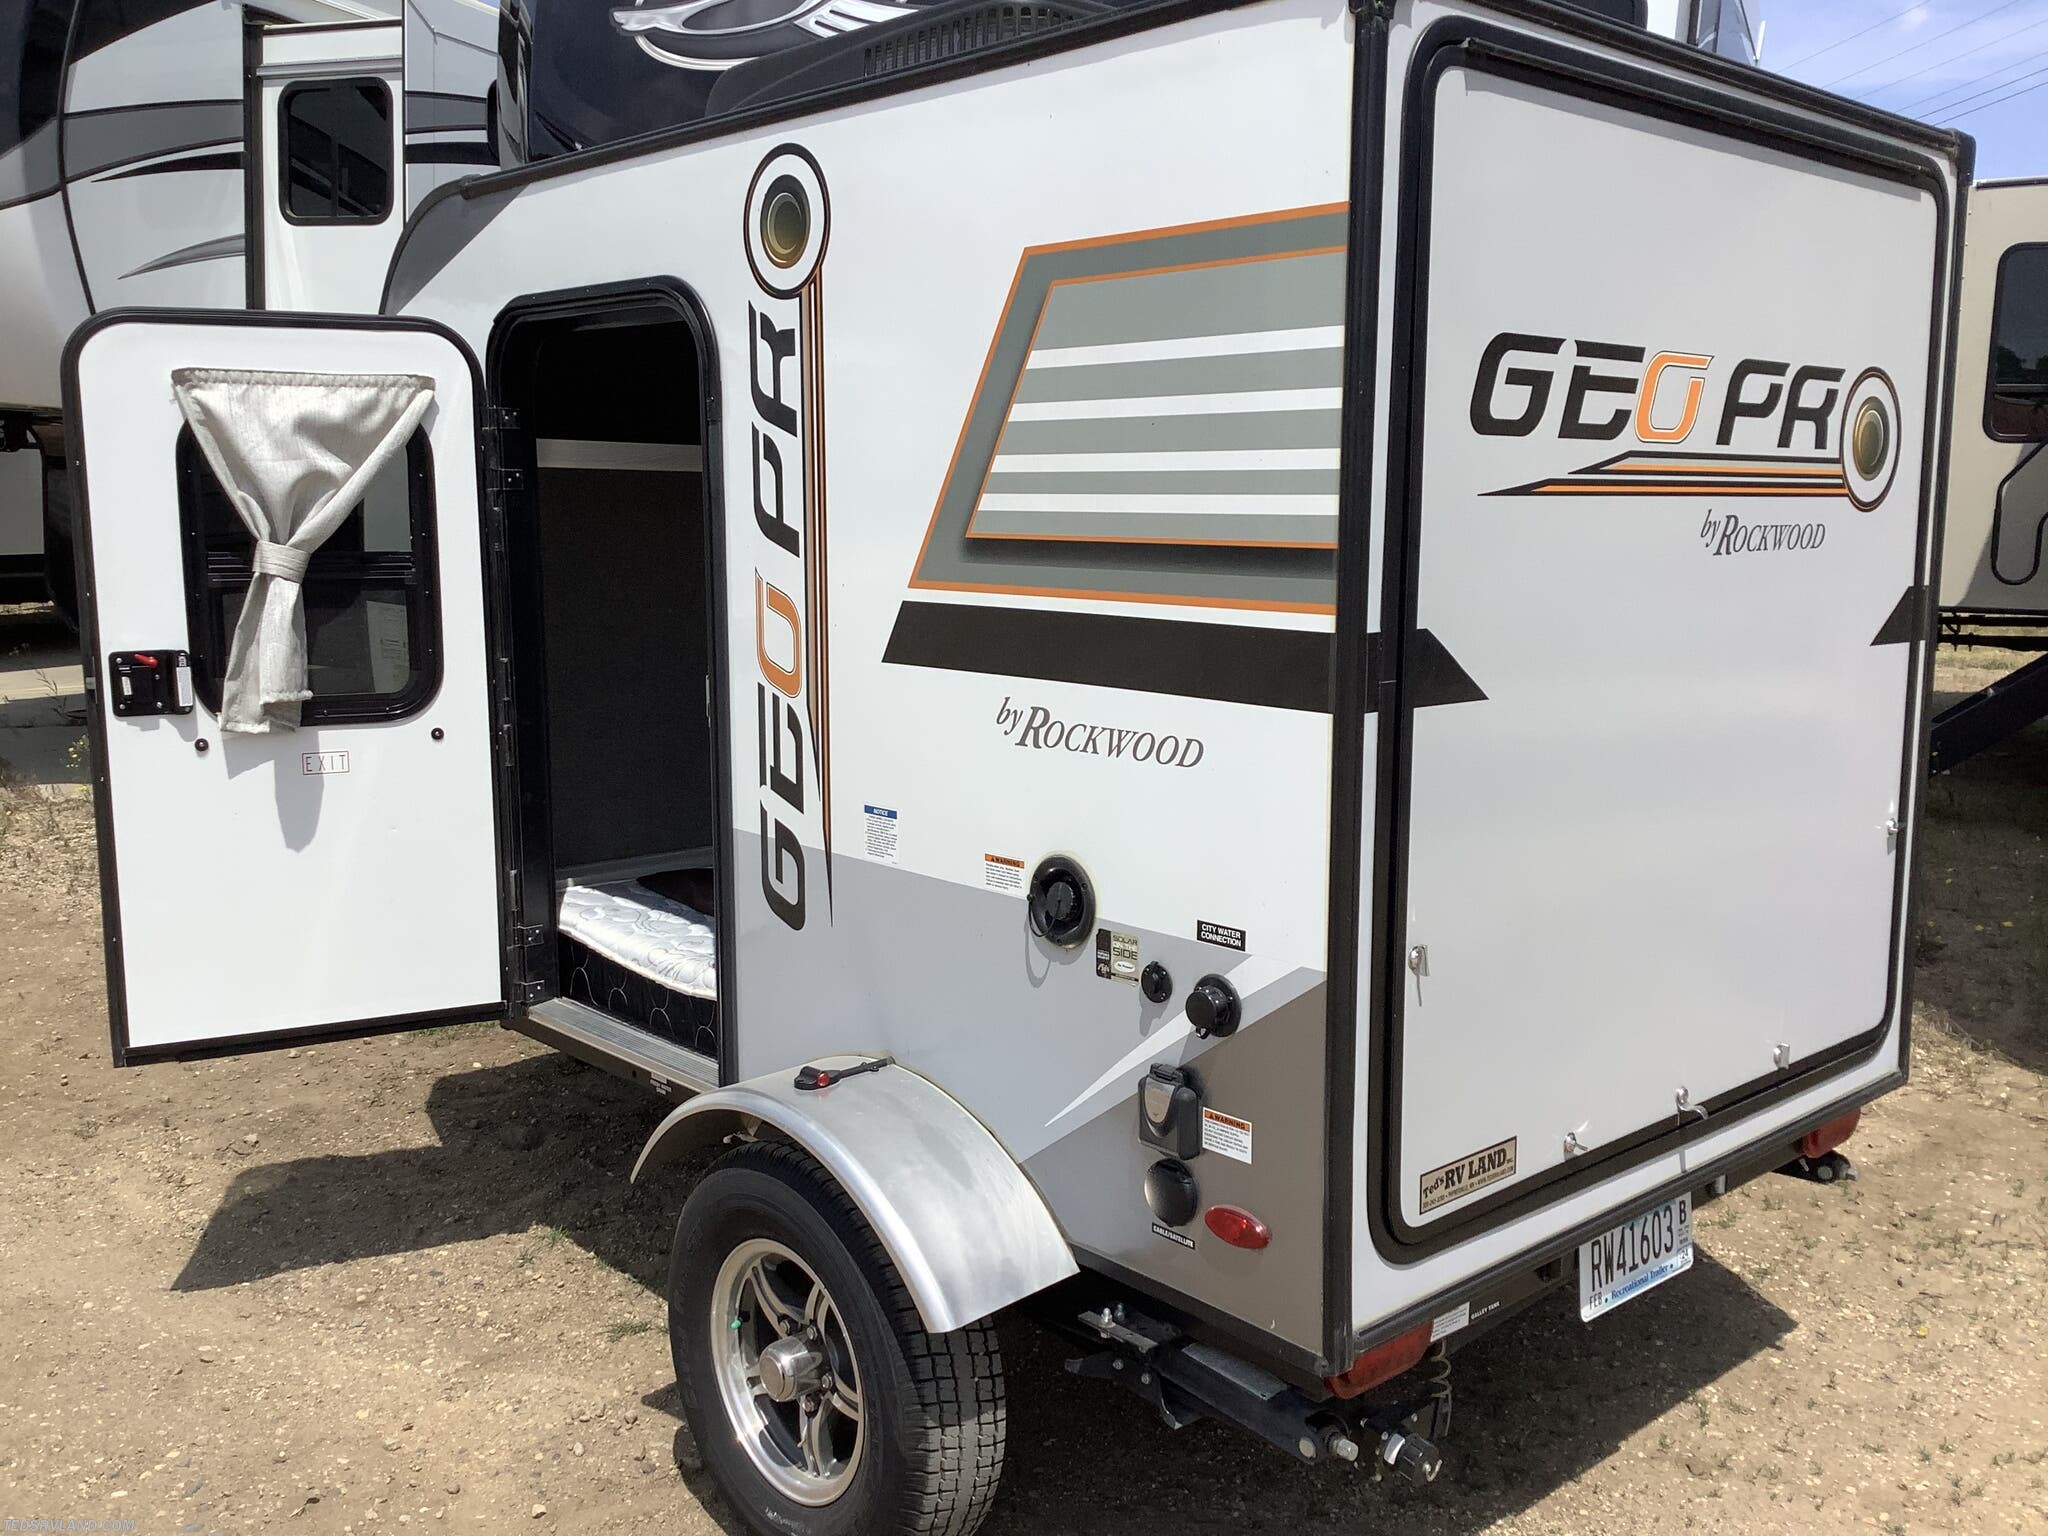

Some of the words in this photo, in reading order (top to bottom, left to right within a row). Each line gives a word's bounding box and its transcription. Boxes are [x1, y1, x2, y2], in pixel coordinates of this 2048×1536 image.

[1470, 332, 1714, 444] GEO
[1700, 509, 1721, 549] by
[1713, 514, 1827, 556] ROCKWOOD
[754, 566, 806, 931] GEO
[996, 696, 1024, 736] by
[1015, 706, 1205, 768] ROCKWOOD
[305, 754, 346, 772] EXIT
[1112, 934, 1138, 946] SOLAR
[1200, 931, 1242, 947] CONNECTION
[1201, 923, 1217, 933] CITY
[1217, 926, 1241, 939] WATER
[1112, 946, 1138, 961] SIDE
[1214, 1113, 1246, 1130] WARNING
[1444, 1163, 1466, 1190] RV
[1467, 1147, 1507, 1180] LAND
[1591, 1204, 1674, 1293] RW41603
[1611, 1272, 1649, 1300] Recreational
[1650, 1263, 1669, 1280] Trailer
